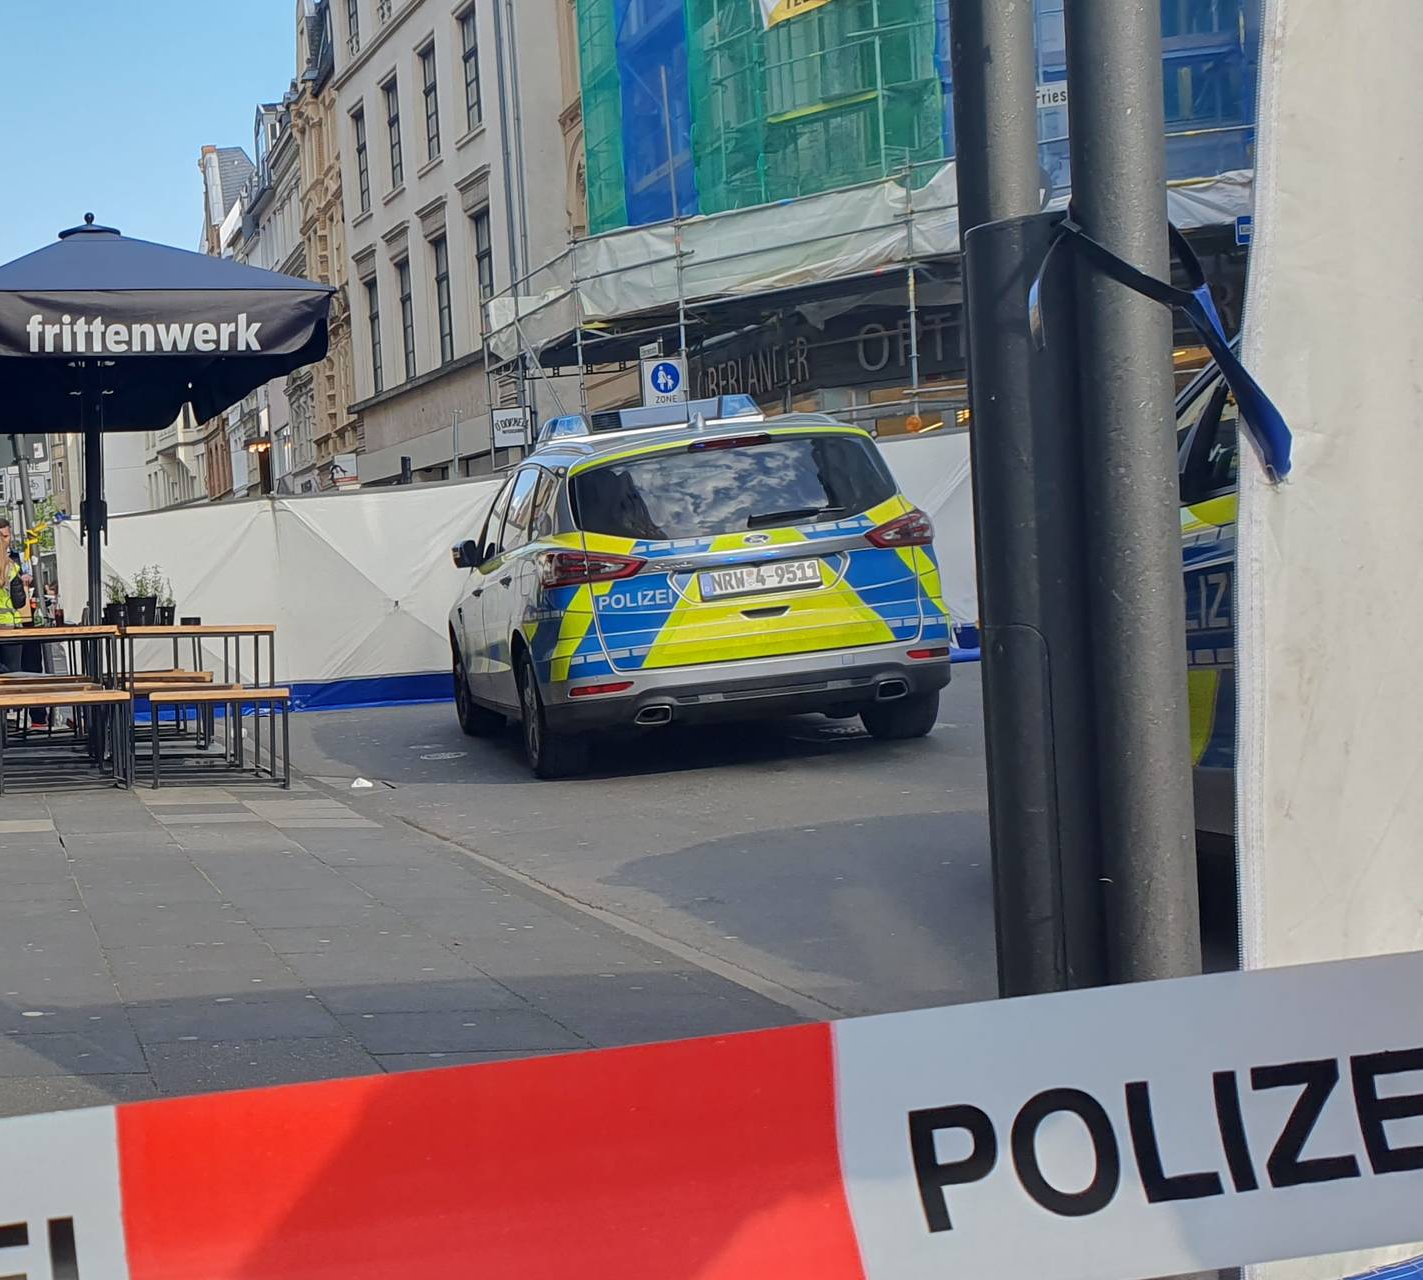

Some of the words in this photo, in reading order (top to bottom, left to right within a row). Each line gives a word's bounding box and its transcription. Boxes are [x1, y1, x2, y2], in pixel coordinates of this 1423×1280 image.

[26, 313, 263, 353] frittenwerk
[655, 395, 678, 404] ZONE
[712, 570, 745, 592] NRW
[756, 562, 820, 587] 4-9511
[598, 589, 673, 611] POLIZEI
[908, 1047, 1423, 1233] POLIZE
